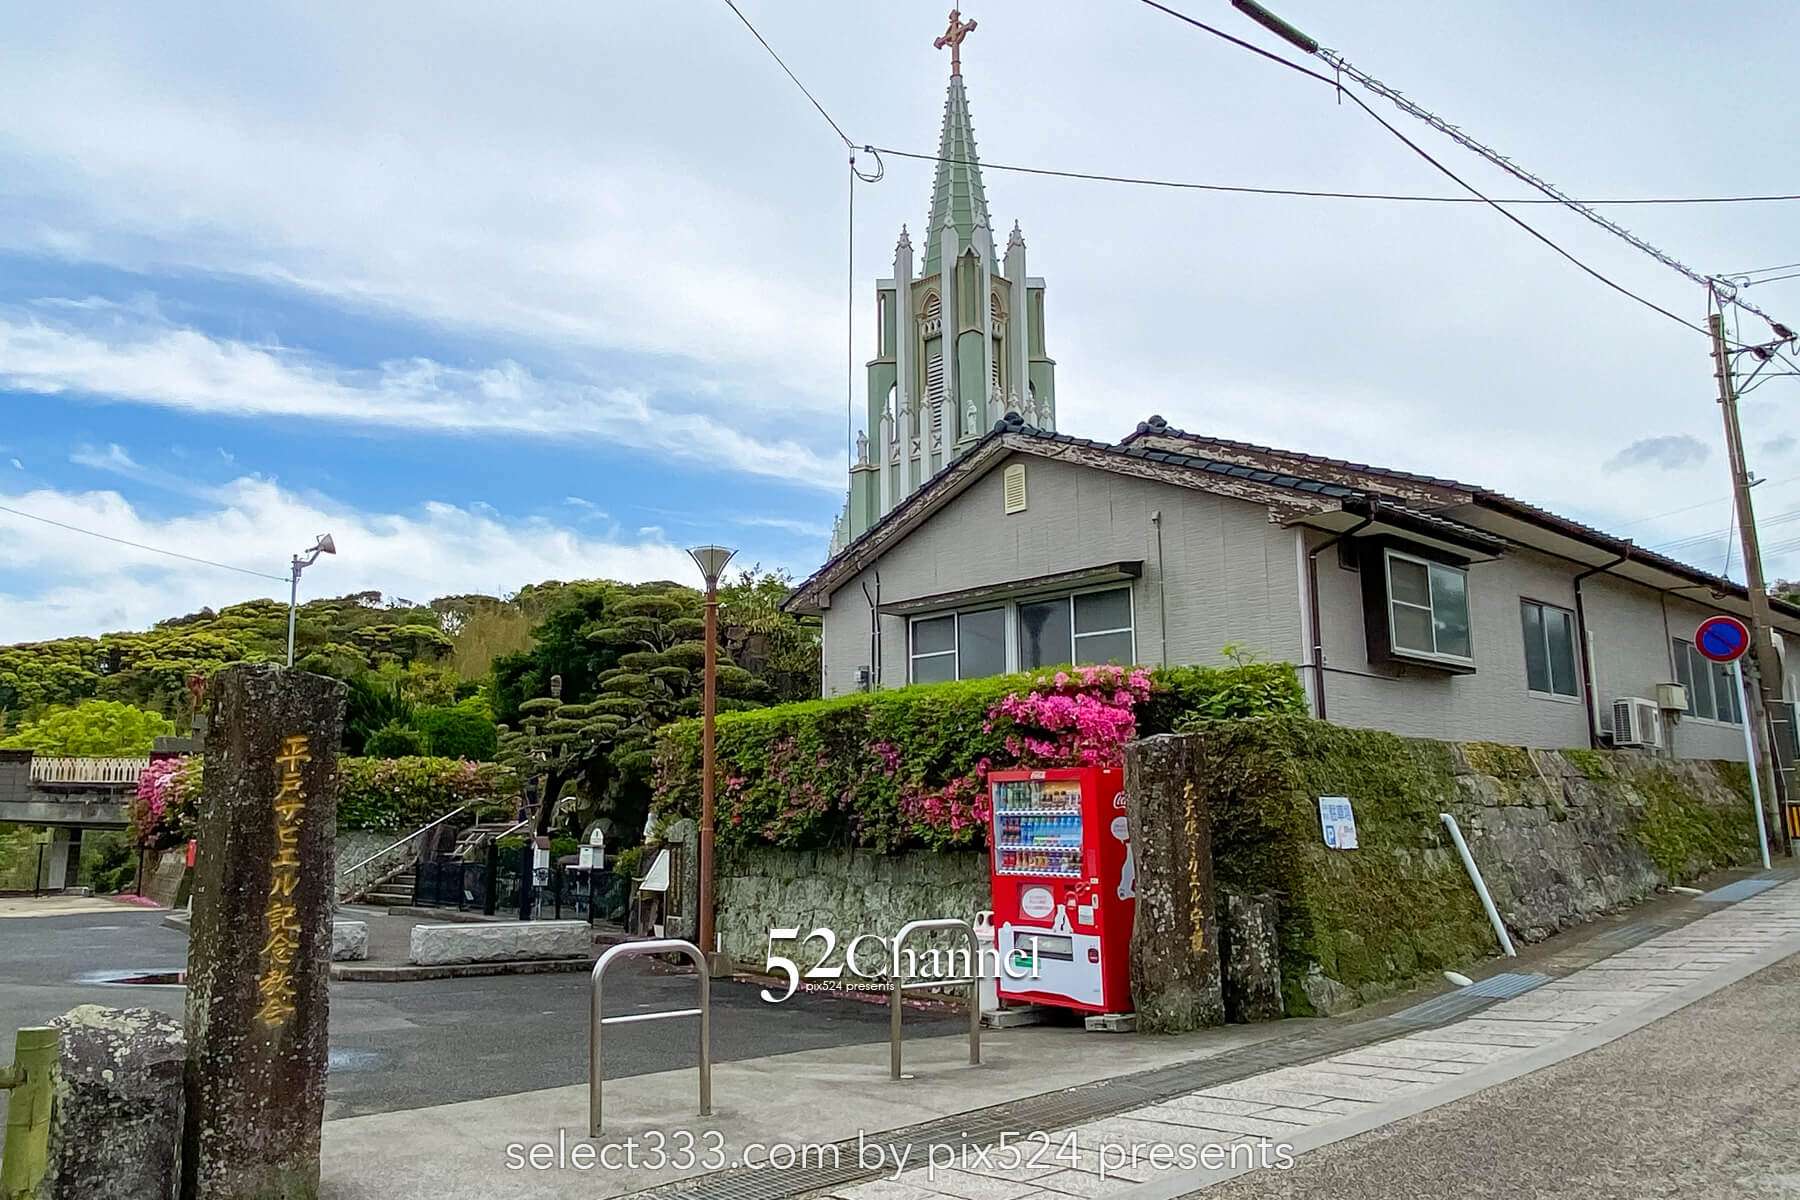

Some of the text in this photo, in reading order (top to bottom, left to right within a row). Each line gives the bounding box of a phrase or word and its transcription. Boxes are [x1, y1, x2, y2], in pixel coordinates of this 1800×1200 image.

[253, 736, 313, 1025] 平戸ザビエル記念教会
